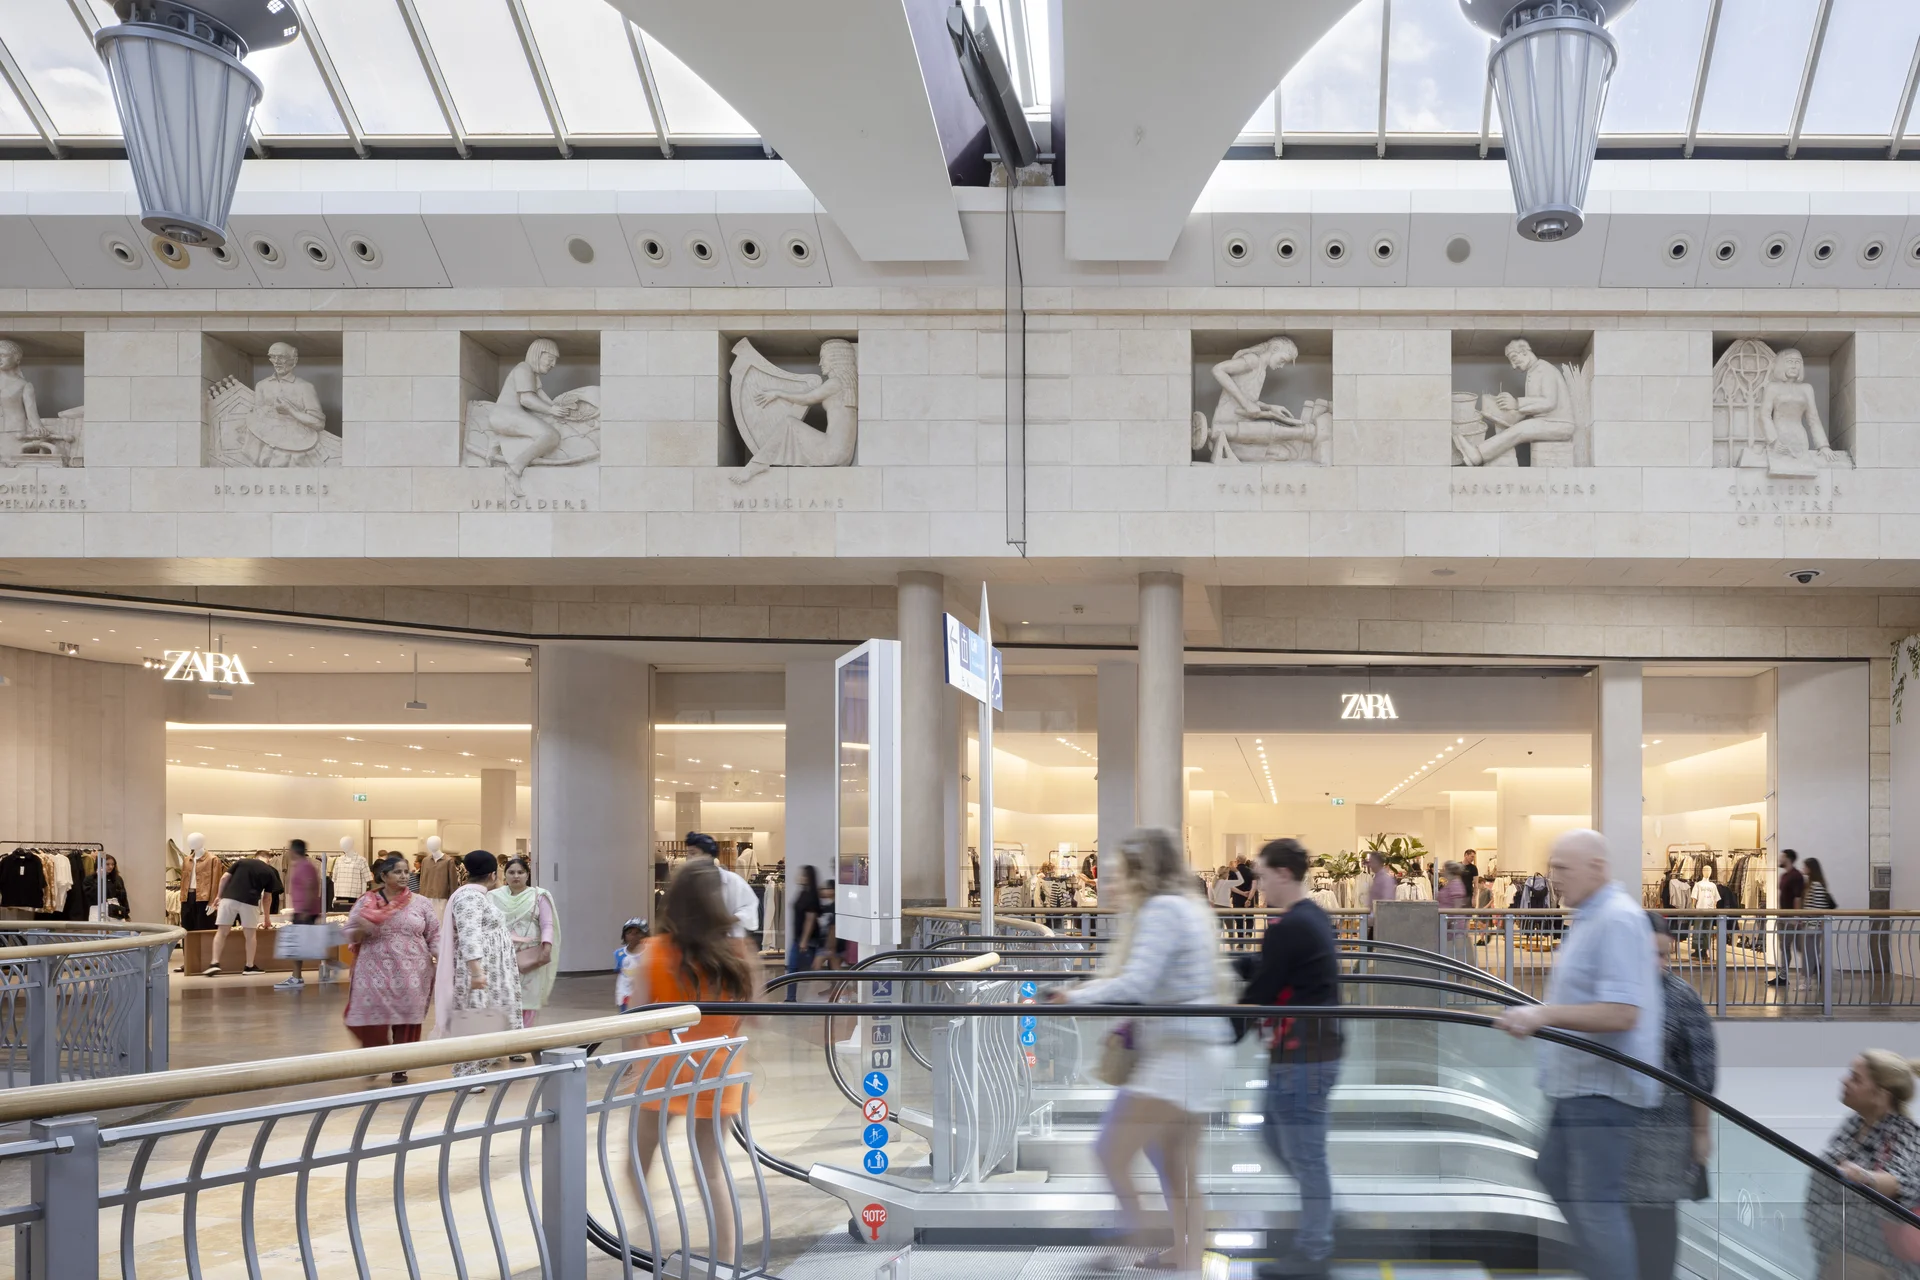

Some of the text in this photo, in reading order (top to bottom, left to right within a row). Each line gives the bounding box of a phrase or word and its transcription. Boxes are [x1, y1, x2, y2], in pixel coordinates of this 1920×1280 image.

[59, 484, 70, 495] &
[213, 484, 330, 496] BRODERERS
[1217, 483, 1307, 496] TURNERS
[1448, 483, 1597, 495] BASKETMAKERS
[1832, 485, 1842, 497] &
[471, 499, 588, 510] UPHOLDERS
[733, 498, 844, 509] MUSICIANS
[1735, 500, 1833, 511] PAINTERS
[1737, 515, 1833, 526] OF GLASS
[163, 650, 255, 685] ZARA
[1341, 693, 1399, 719] ZARA
